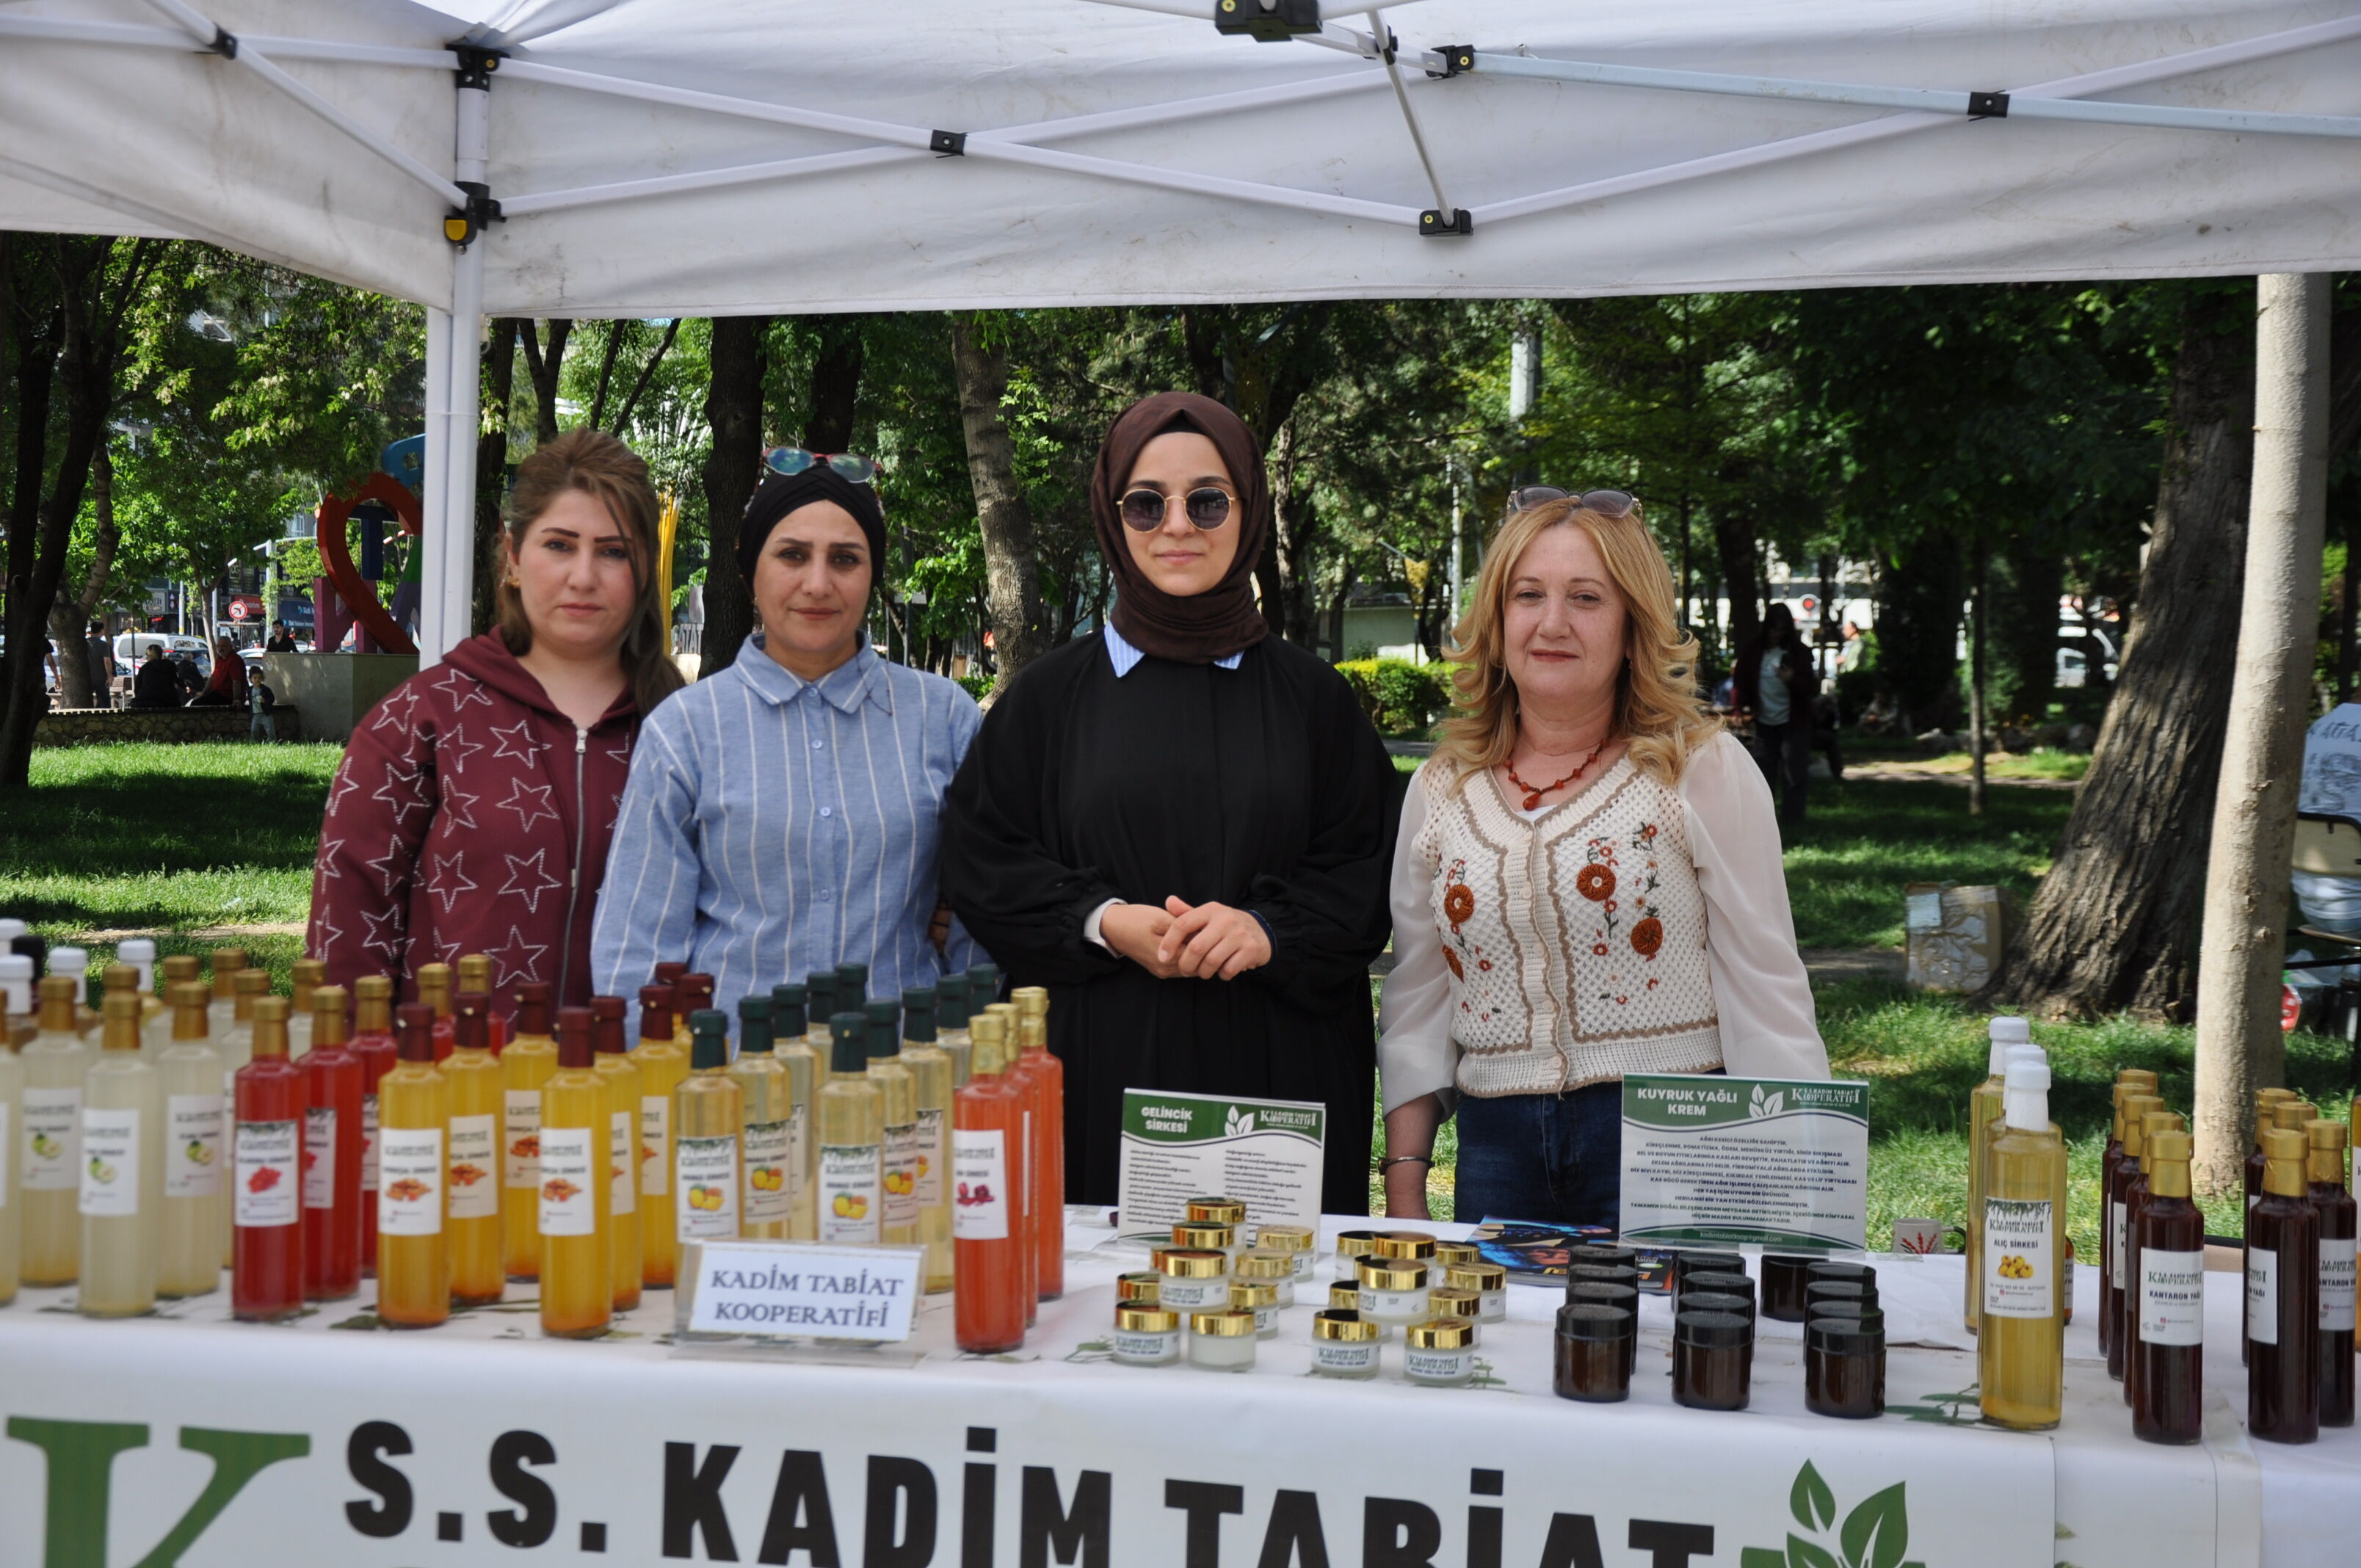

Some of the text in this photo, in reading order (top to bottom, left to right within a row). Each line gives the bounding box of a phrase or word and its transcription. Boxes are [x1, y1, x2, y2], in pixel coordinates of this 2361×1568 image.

[1637, 1088, 1737, 1103] KUYRUK YAĞLI
[1141, 1105, 1192, 1120] GELİNCİK
[1667, 1103, 1707, 1116] KREM
[1145, 1119, 1188, 1133] SİRKESİ
[1993, 1238, 2038, 1249] ALIÇ SİRKESİ
[711, 1264, 904, 1297] KADİM TABİAT
[2150, 1290, 2188, 1300] KANTARON
[714, 1300, 889, 1328] KOOPERATİFİ
[345, 1420, 607, 1553] S.S.
[662, 1426, 1111, 1568] KADİM
